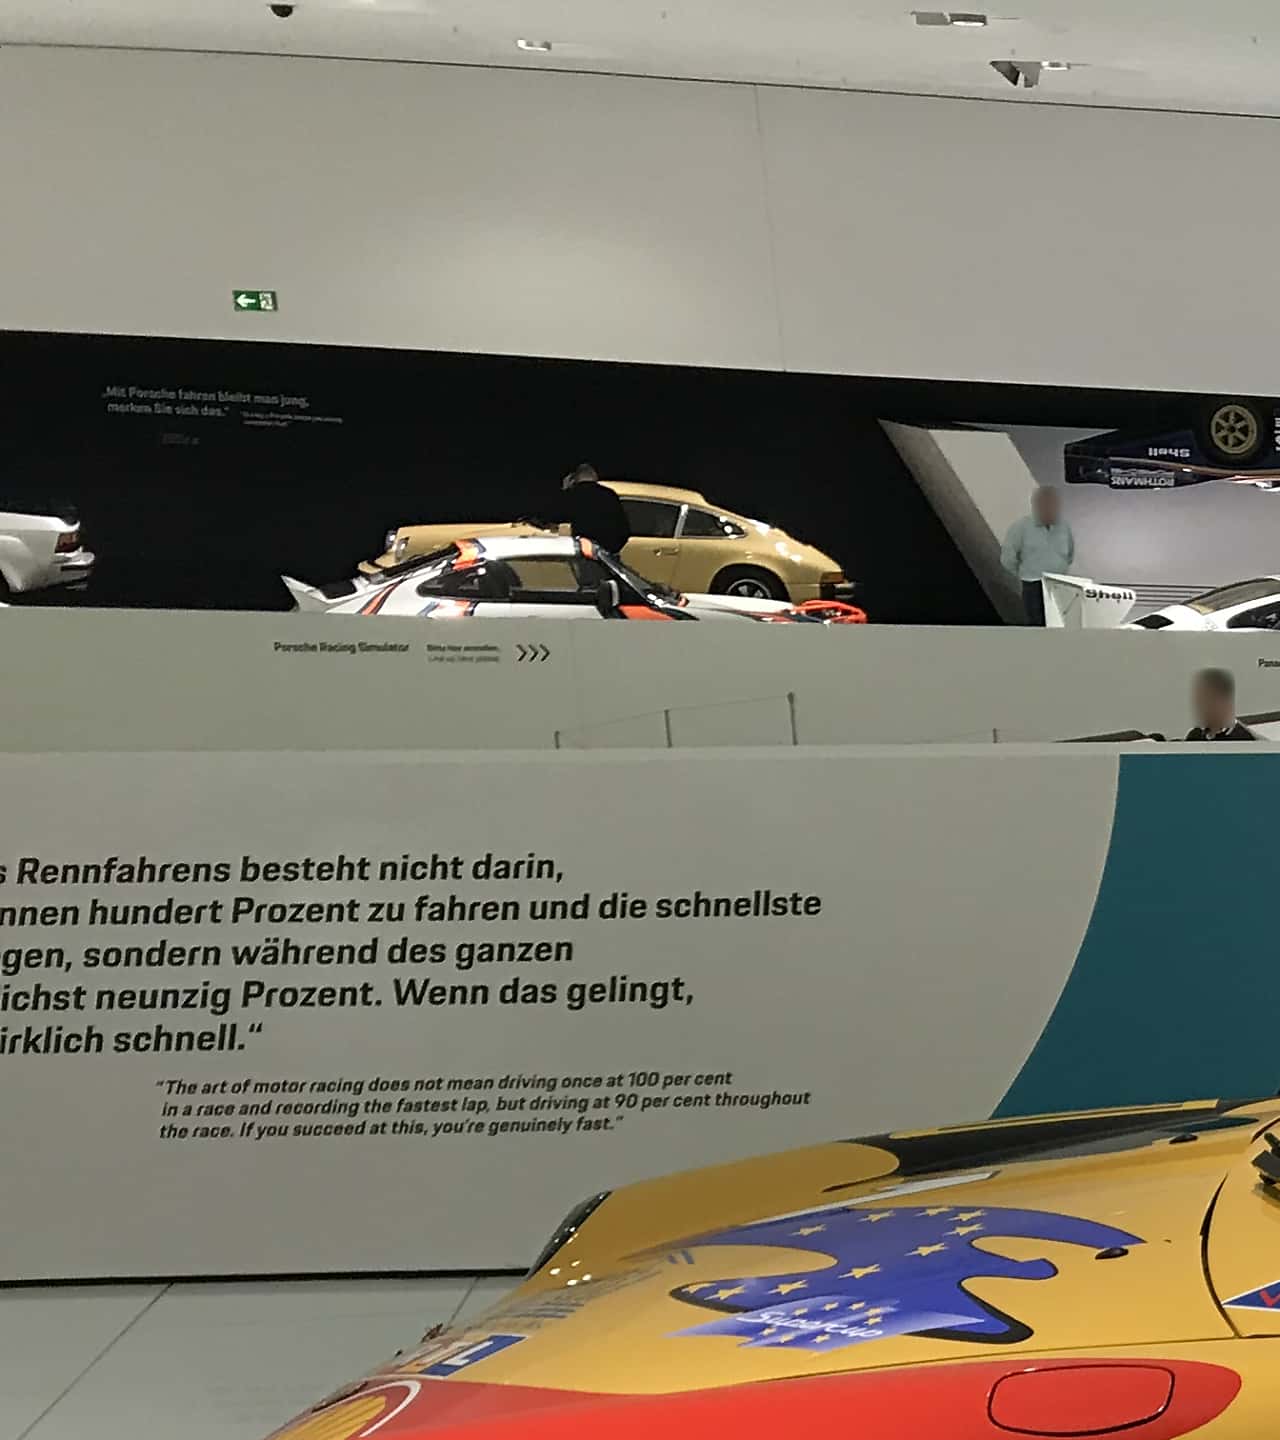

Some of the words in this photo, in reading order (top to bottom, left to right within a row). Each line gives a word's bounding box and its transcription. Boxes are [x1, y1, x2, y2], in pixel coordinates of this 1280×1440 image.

[129, 387, 175, 399] Porsche
[1147, 446, 1191, 458] Shell
[1085, 587, 1135, 602] Shell
[274, 642, 317, 652] Porsche
[319, 642, 356, 655] Racing
[358, 642, 409, 652] Simulator
[17, 856, 232, 885] Rennfahrens
[240, 854, 371, 883] besteht
[379, 853, 464, 881] nicht
[472, 852, 564, 883] darin,
[89, 897, 223, 926] hundert
[231, 896, 361, 924] Prozent
[367, 901, 405, 923] zu
[415, 895, 520, 922] fahren
[529, 893, 590, 920] und
[599, 892, 648, 919] die
[655, 890, 823, 919] schnellste
[83, 939, 222, 968] sondern
[231, 936, 379, 966] während
[387, 936, 447, 964] des
[455, 939, 574, 971] ganzen
[95, 980, 232, 1016] neunzig
[241, 980, 383, 1009] Prozent.
[393, 977, 490, 1006] Wenn
[500, 976, 558, 1005] das
[566, 974, 694, 1012] gelingt,
[201, 1081, 226, 1094] art
[230, 1079, 251, 1094] of
[253, 1080, 307, 1093] motor
[309, 1078, 364, 1096] racing
[368, 1078, 410, 1092] does
[413, 1077, 444, 1091] not
[446, 1076, 494, 1092] mean
[499, 1075, 557, 1092] driving
[561, 1077, 602, 1089] once
[605, 1074, 624, 1088] at
[627, 1072, 660, 1088] 100
[661, 1075, 692, 1090] per
[694, 1072, 733, 1086] cent
[162, 1102, 178, 1117] in
[182, 1105, 192, 1116] a
[196, 1104, 235, 1116] race
[238, 1100, 272, 1115] and
[275, 1099, 359, 1118] recording
[363, 1098, 392, 1113] the
[396, 1097, 459, 1113] fastest
[461, 1096, 491, 1115] lap,
[496, 1096, 525, 1111] but
[529, 1095, 589, 1113] driving
[592, 1095, 611, 1109] at
[614, 1093, 638, 1108] 90
[640, 1096, 670, 1112] per
[672, 1094, 711, 1107] cent
[715, 1091, 811, 1110] throughout
[159, 1124, 188, 1139] the
[192, 1126, 234, 1138] race.
[239, 1121, 254, 1138] If
[255, 1124, 288, 1140] you
[292, 1120, 366, 1137] succeed
[369, 1121, 387, 1135] at
[391, 1119, 428, 1136] this,
[487, 1117, 572, 1136] genuinely
[737, 1307, 887, 1340] Supercup
